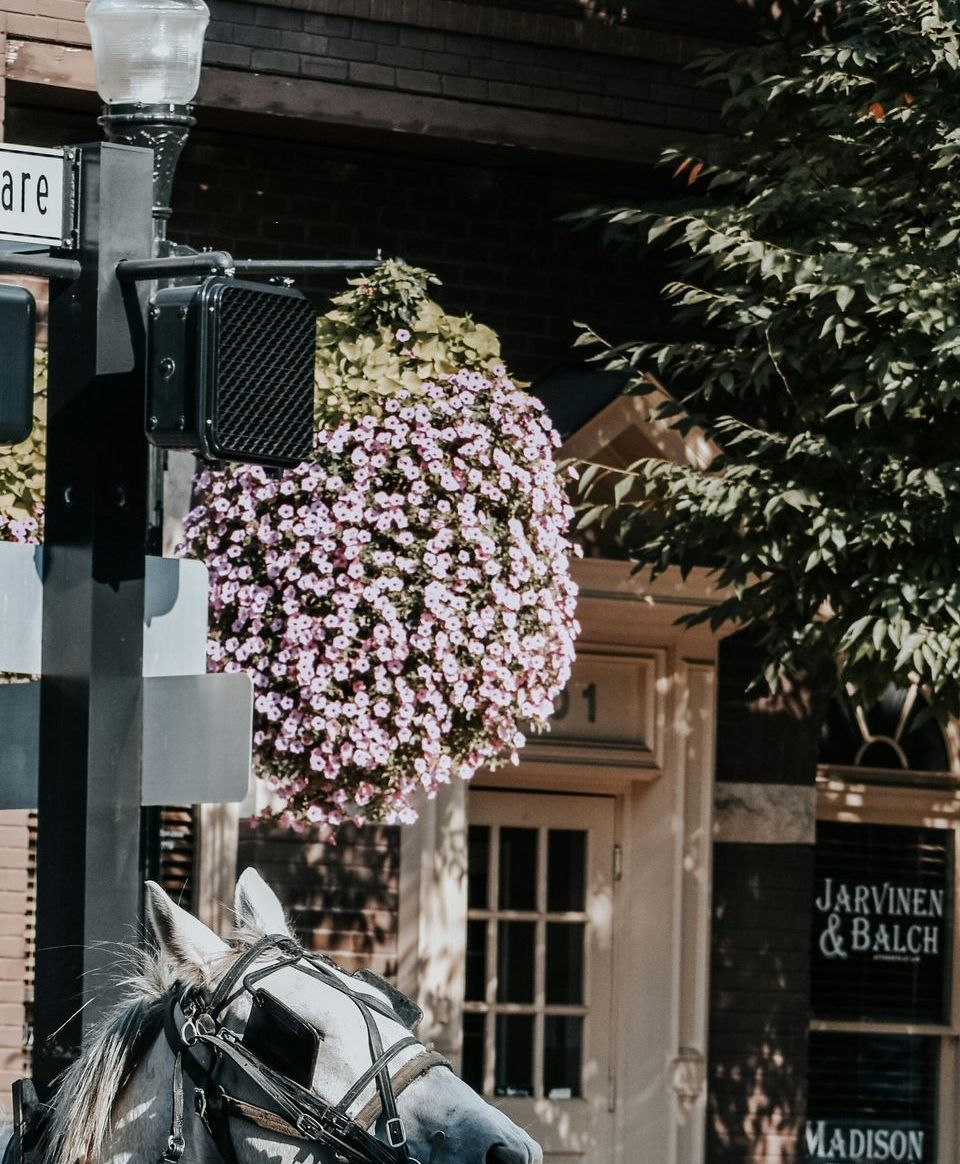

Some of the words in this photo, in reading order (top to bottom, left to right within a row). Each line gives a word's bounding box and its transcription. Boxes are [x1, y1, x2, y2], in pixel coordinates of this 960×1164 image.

[815, 878, 944, 917] JARVINEN
[819, 913, 848, 959] &
[851, 916, 939, 954] BALCH
[805, 1120, 924, 1161] MADISON
